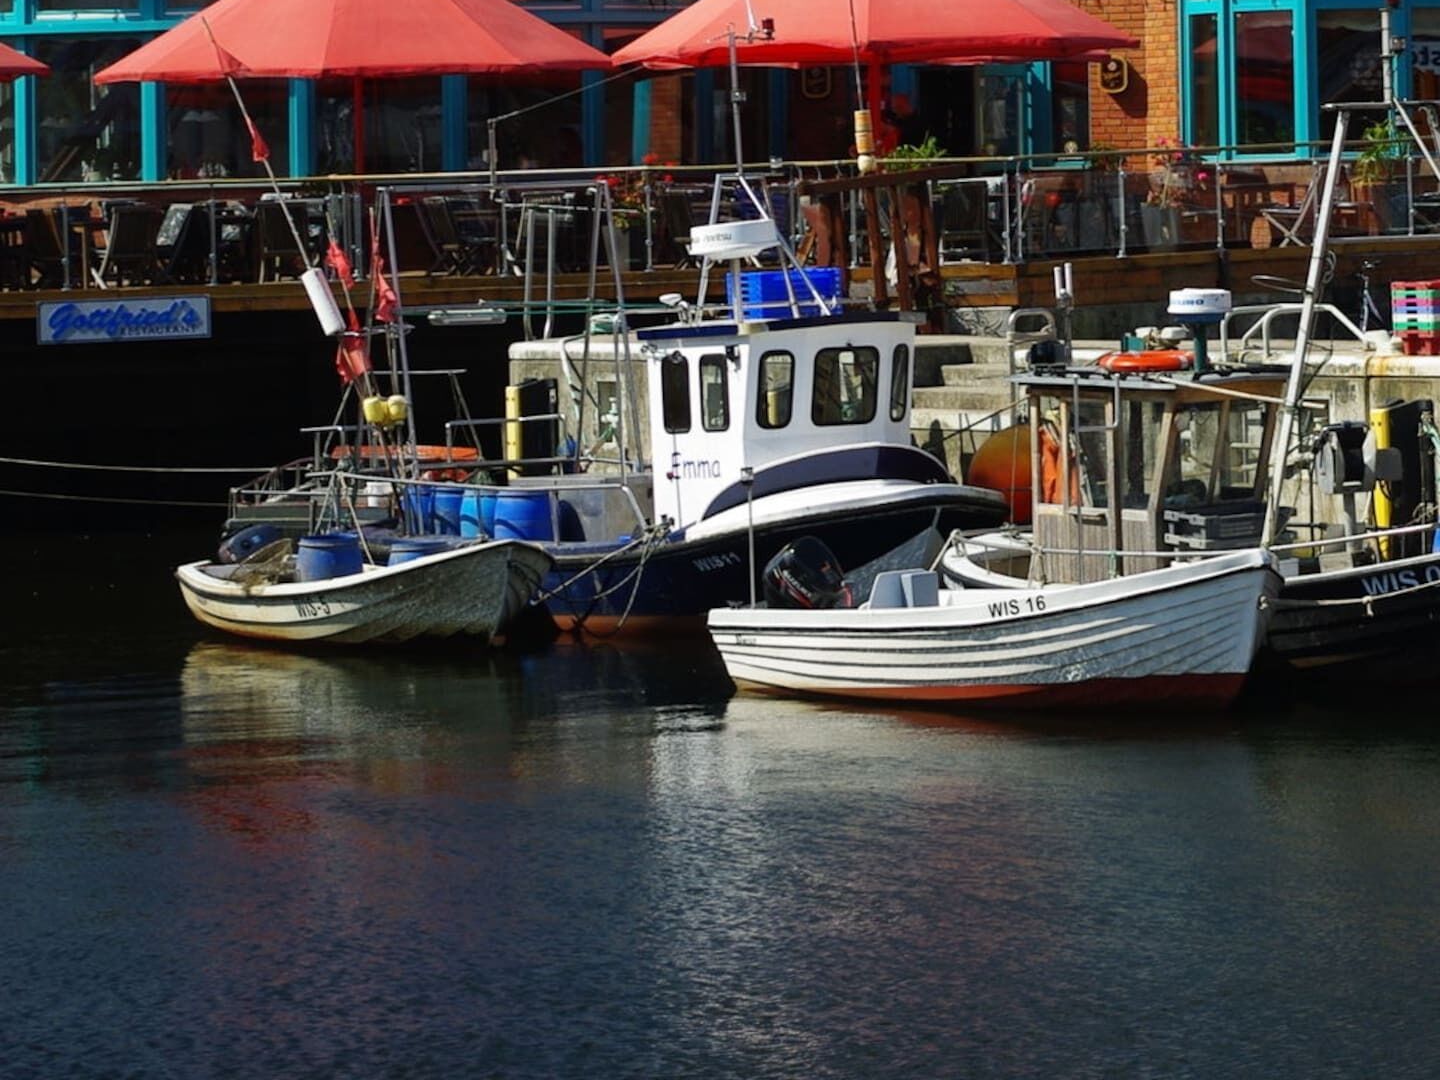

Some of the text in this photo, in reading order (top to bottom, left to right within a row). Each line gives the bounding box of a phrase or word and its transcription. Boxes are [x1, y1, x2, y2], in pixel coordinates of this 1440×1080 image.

[49, 300, 200, 343] Gottfried's
[671, 451, 721, 480] Emma
[1361, 569, 1420, 596] WIS
[988, 594, 1046, 618] WIS 16
